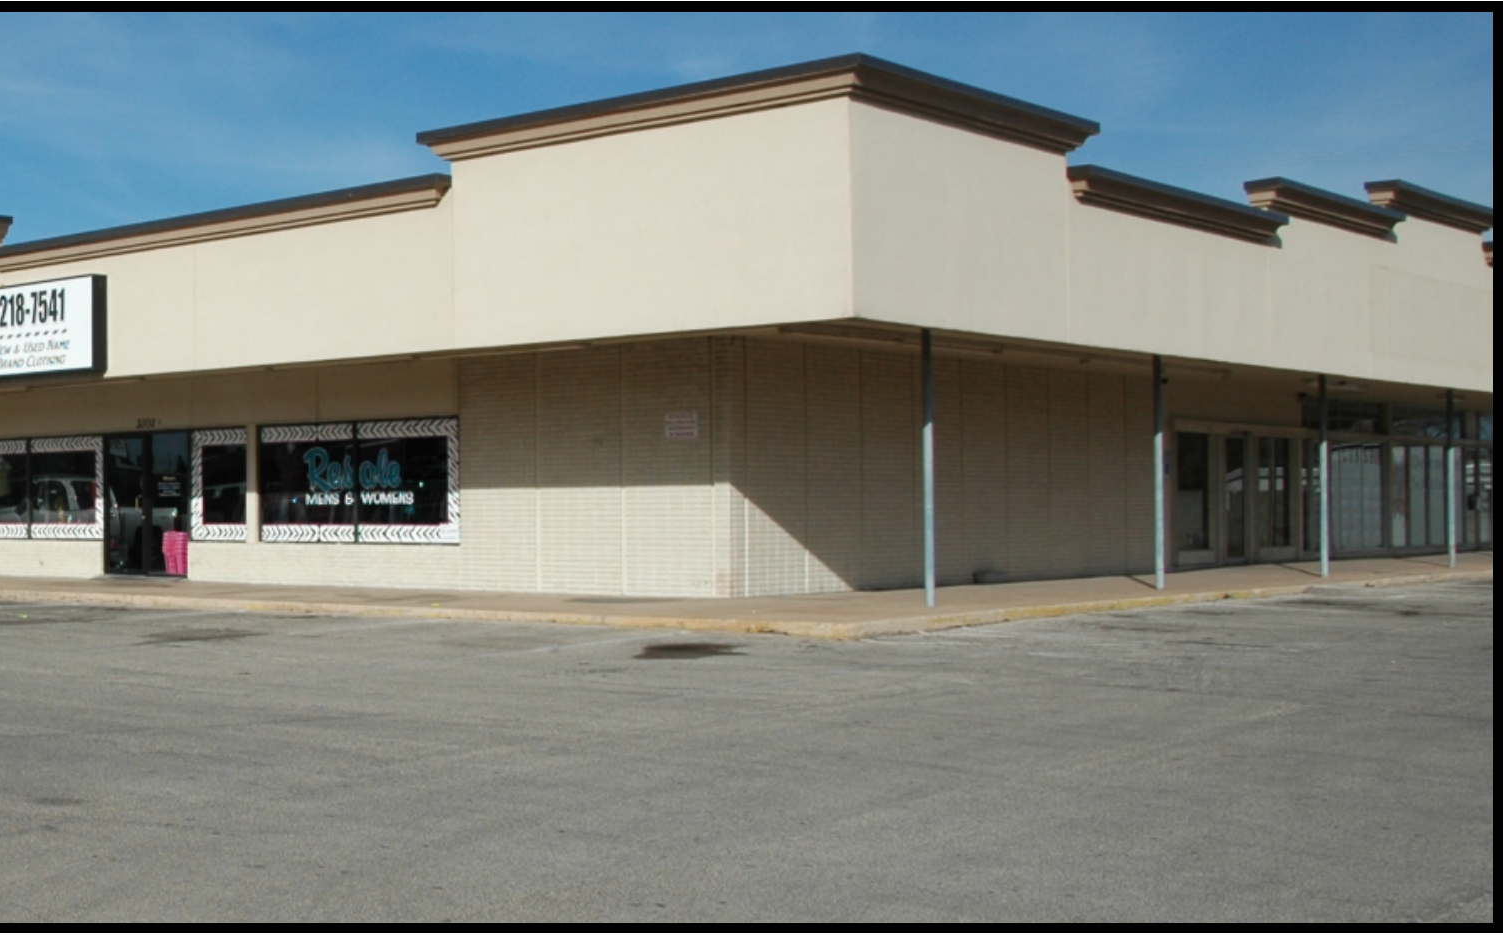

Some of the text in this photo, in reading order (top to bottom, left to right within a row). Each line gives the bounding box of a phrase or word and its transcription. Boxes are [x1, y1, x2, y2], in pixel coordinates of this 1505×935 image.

[305, 490, 415, 505] MENS & WOMENS
